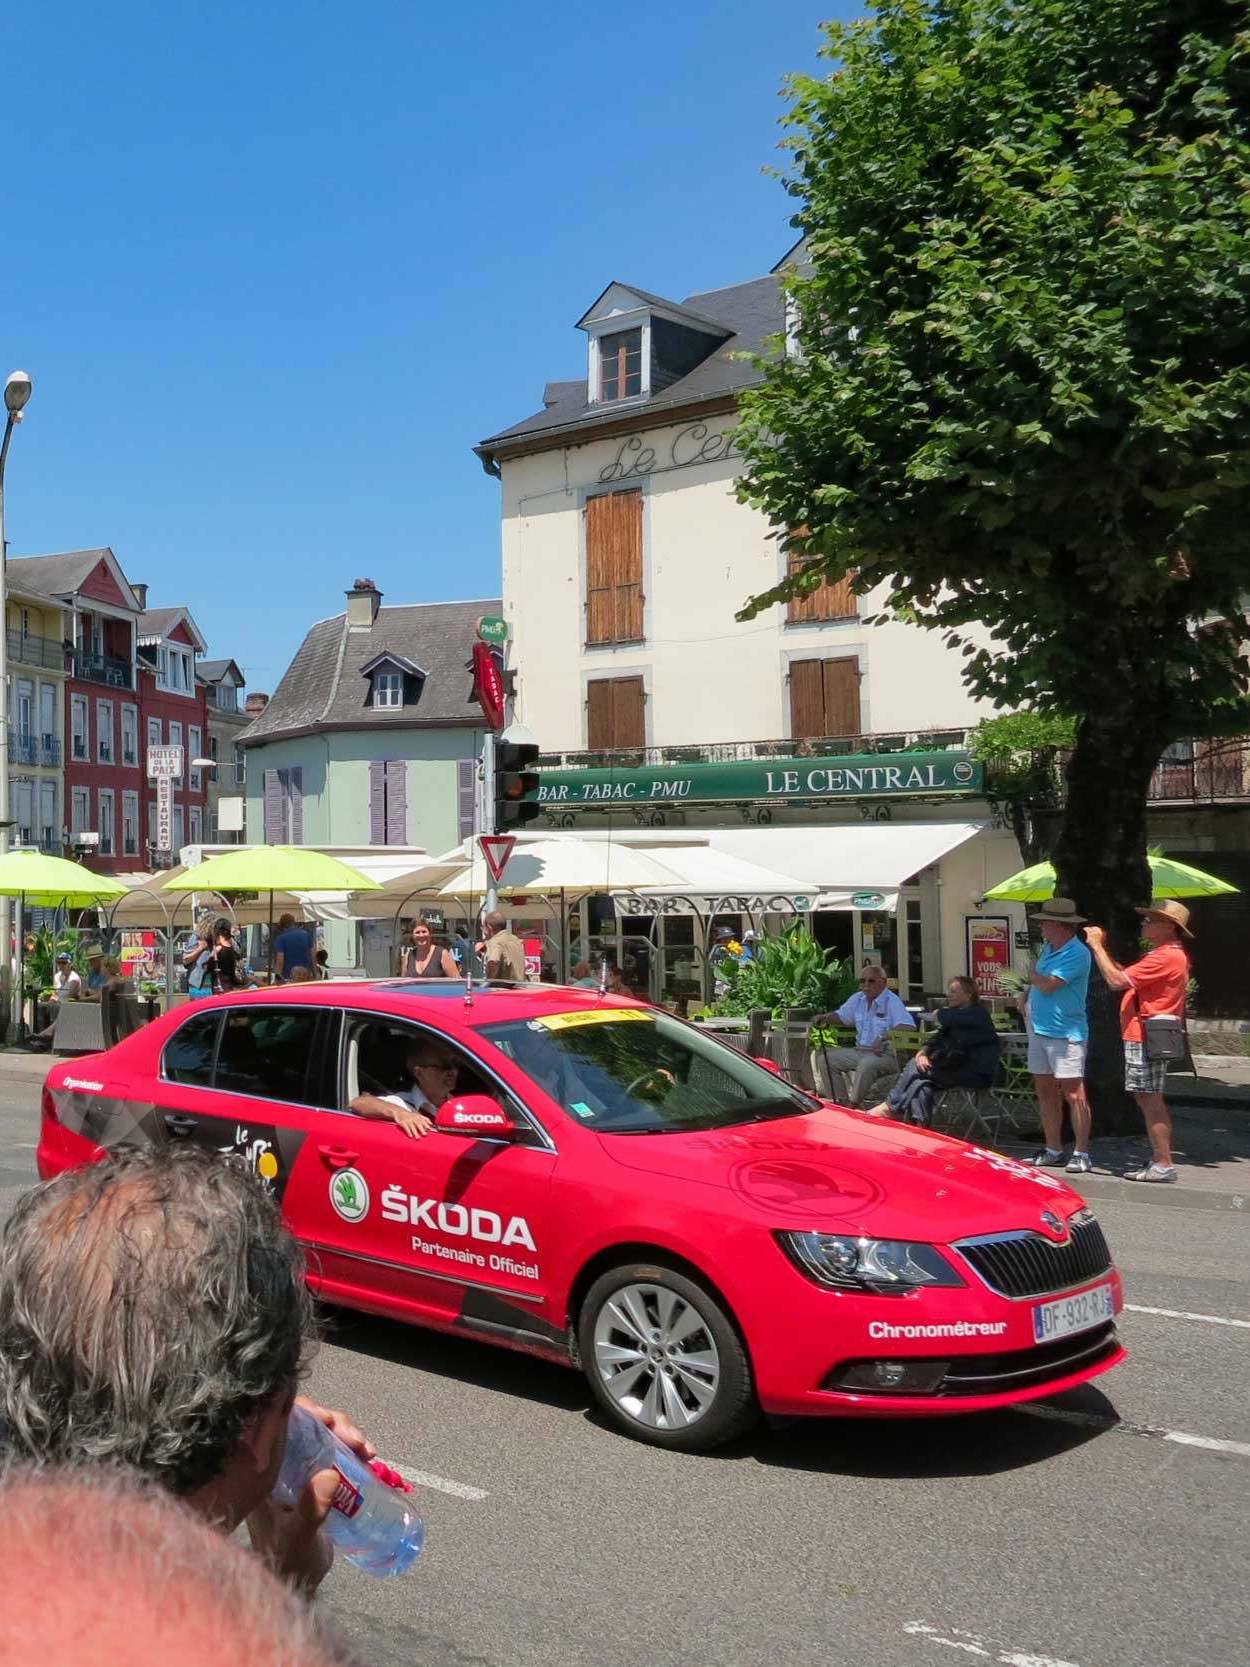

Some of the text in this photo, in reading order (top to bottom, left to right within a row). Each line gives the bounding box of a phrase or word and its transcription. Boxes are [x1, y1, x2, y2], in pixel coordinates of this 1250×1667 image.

[600, 437, 657, 482] Le
[488, 667, 501, 704] TABAC
[153, 766, 175, 775] PAIX
[765, 764, 947, 794] LE CENTRAL
[537, 785, 569, 801] BAR
[581, 782, 637, 799] TABAC
[649, 780, 693, 797] PMU
[160, 779, 169, 848] RESTAURANT
[627, 898, 681, 915] BAR
[703, 896, 783, 912] TABAC
[976, 961, 1002, 973] VOUS
[62, 1076, 104, 1092] Organisation
[454, 1111, 504, 1124] ŠKODA
[381, 1184, 538, 1252] ŠKODA
[411, 1235, 540, 1280] Partenaire Officiel
[868, 1320, 1007, 1339] Chronométreur
